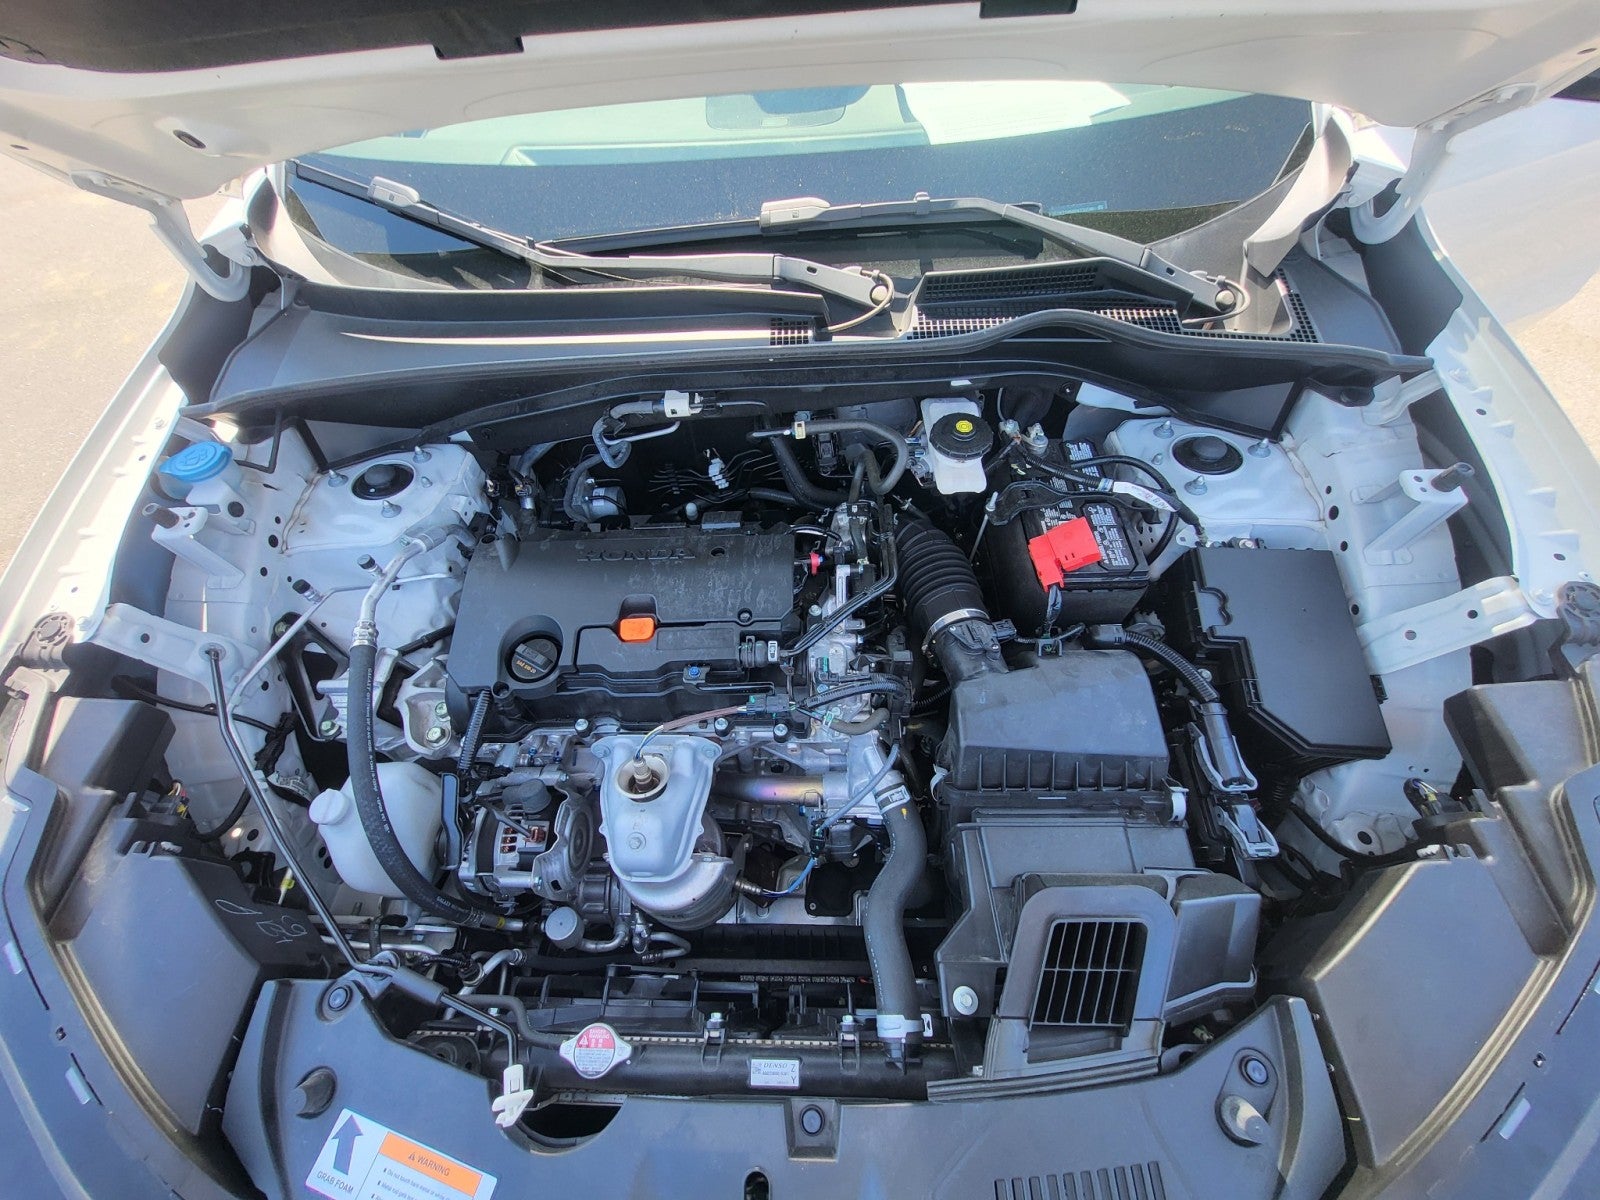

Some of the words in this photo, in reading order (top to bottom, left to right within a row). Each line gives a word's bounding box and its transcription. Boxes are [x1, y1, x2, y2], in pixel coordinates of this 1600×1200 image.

[577, 547, 695, 562] HONDA
[790, 1063, 796, 1073] Z
[790, 1075, 797, 1084] Y
[416, 1155, 451, 1177] WARNING
[316, 1170, 335, 1186] GRAB
[334, 1178, 354, 1195] FOAM
